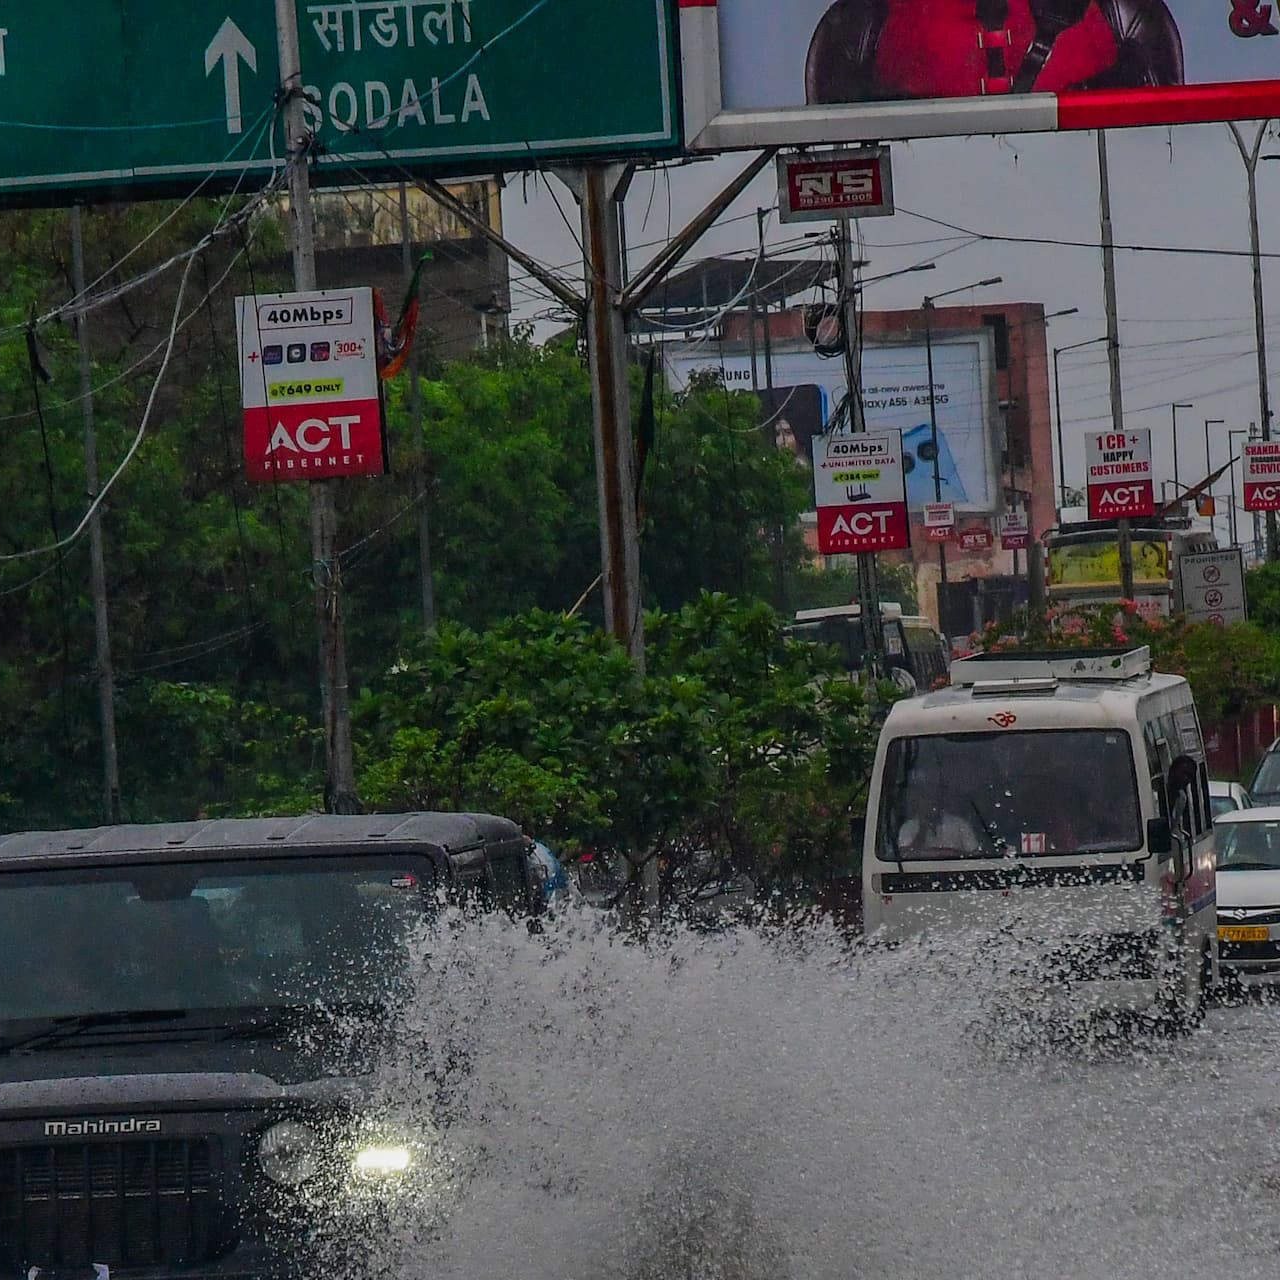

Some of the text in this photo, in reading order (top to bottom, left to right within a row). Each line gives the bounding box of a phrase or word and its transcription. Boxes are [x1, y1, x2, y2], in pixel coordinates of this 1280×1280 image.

[302, 73, 491, 134] SODALA
[267, 306, 344, 324] 40Mbps
[314, 383, 342, 393] ONLY
[265, 415, 361, 456] ACT
[1106, 433, 1126, 449] CR
[833, 443, 883, 456] 40Mbps
[1103, 450, 1134, 463] HAPPY
[264, 454, 365, 470] FIBERNET
[875, 457, 896, 465] DATA
[1090, 461, 1149, 476] CUSTOMERS
[1099, 485, 1145, 506] ACT
[831, 510, 894, 536] ACT
[930, 527, 950, 537] ACT
[1006, 536, 1024, 545] ACT
